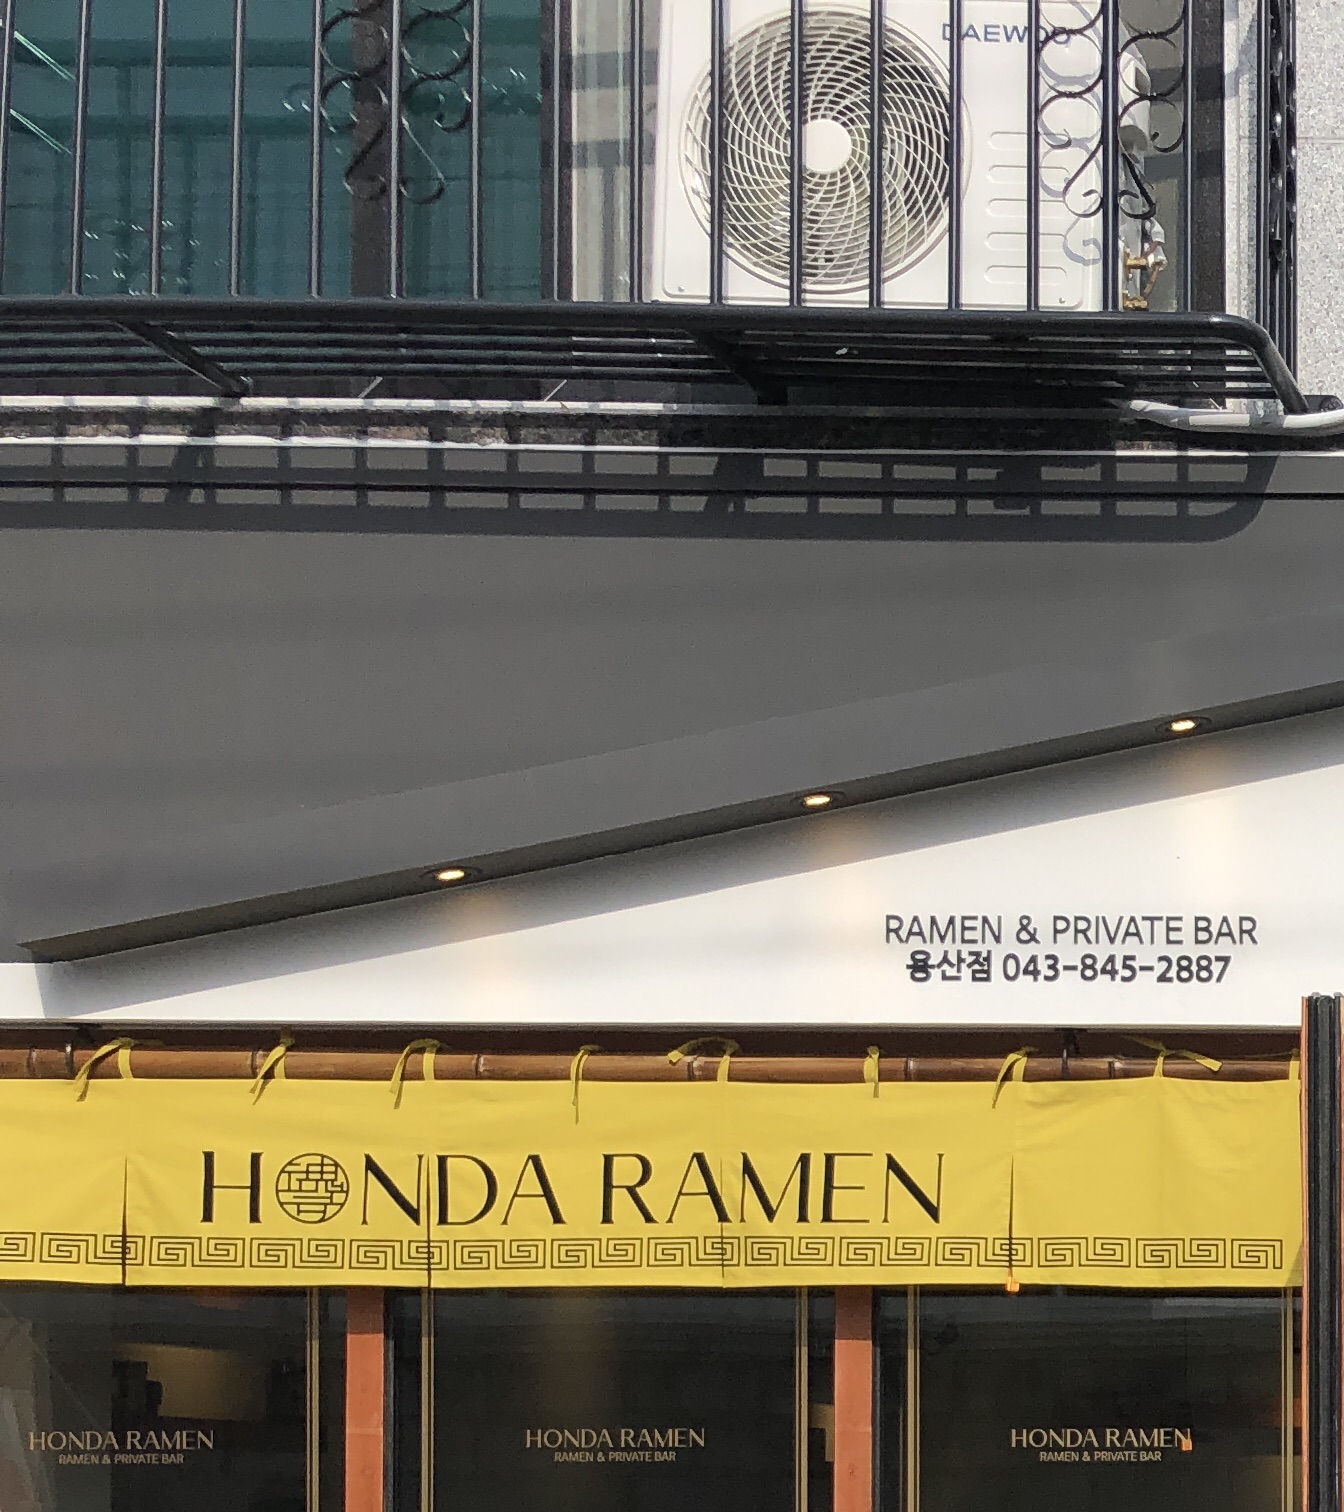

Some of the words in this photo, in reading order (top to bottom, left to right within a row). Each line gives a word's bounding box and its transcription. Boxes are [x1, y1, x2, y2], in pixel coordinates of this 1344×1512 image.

[885, 914, 1002, 945] RAMEN
[1015, 914, 1041, 945] &
[1053, 915, 1184, 945] PRIVATE
[1194, 915, 1258, 945] BAR
[906, 949, 993, 983] 용산점
[1002, 953, 1232, 983] 043-845-2887
[600, 1151, 945, 1225] RAMEN
[29, 1430, 119, 1450] HONDA
[127, 1429, 214, 1450] RAMEN
[525, 1428, 614, 1449] HONDA
[620, 1427, 705, 1448] RAMEN
[1011, 1428, 1099, 1448] HONDA
[1105, 1427, 1191, 1449] RAMEN
[58, 1453, 99, 1465] RAMEN
[102, 1453, 111, 1465] &
[114, 1453, 159, 1465] PRIVATE
[162, 1453, 184, 1465] BAR
[553, 1451, 594, 1463] RAMEN
[596, 1451, 606, 1463] &
[608, 1451, 652, 1463] PRIVATE
[654, 1451, 677, 1463] BAR
[1039, 1451, 1079, 1462] RAMEN
[1082, 1451, 1091, 1462] &
[1094, 1451, 1137, 1462] PRIVATE
[1139, 1451, 1162, 1462] BAR
